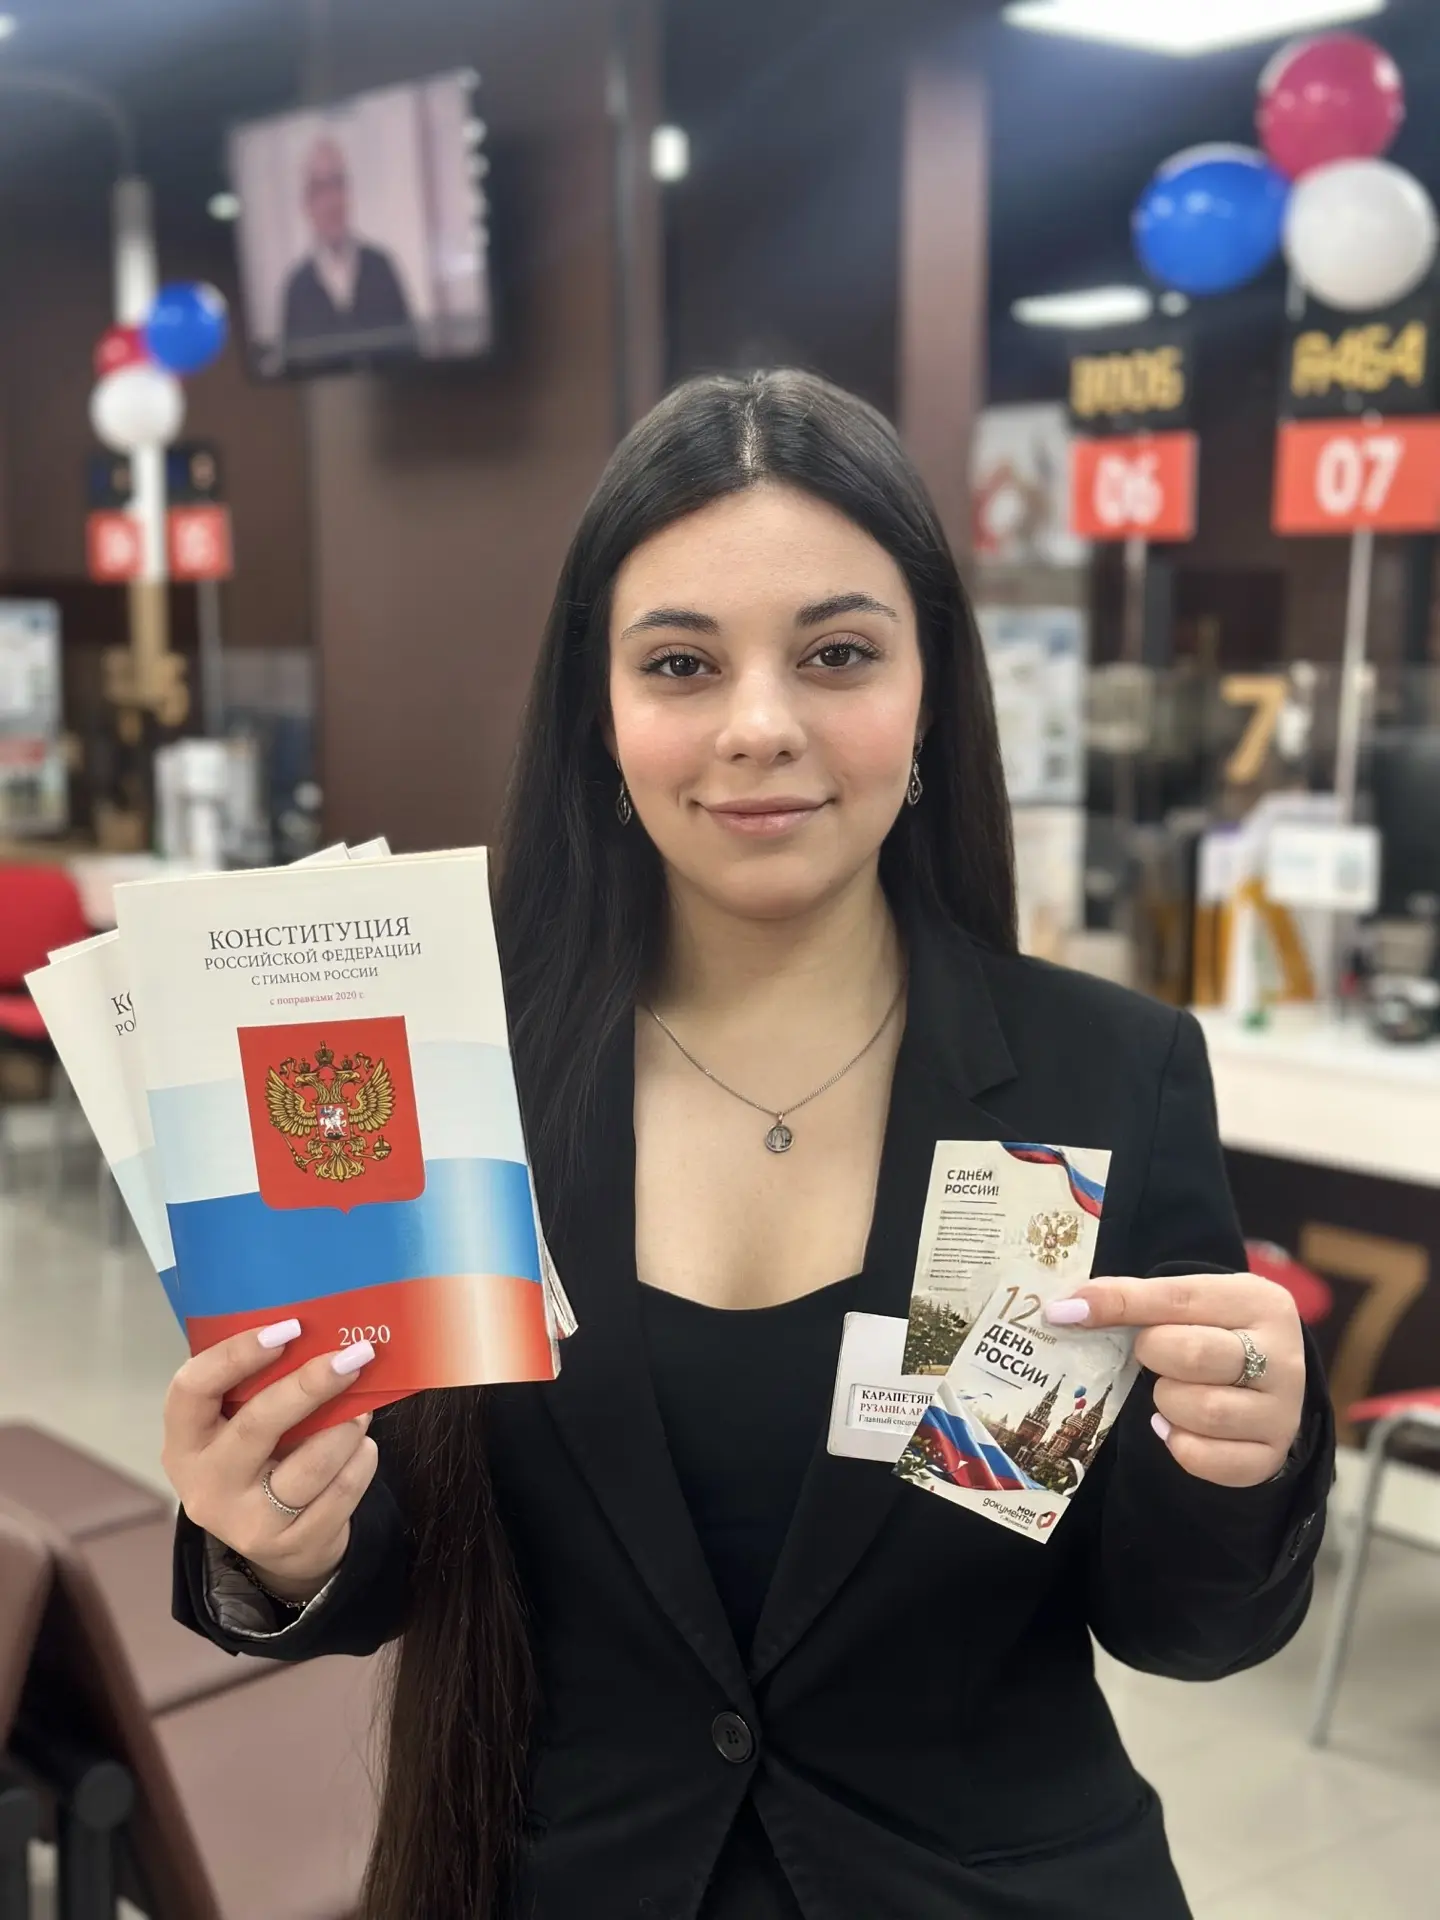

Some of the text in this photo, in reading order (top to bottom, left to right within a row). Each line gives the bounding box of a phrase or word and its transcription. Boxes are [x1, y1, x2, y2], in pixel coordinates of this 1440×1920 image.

[1314, 435, 1403, 515] 07
[208, 916, 412, 950] КОНСТИТУЦИЯ
[204, 942, 422, 970] РОССИЙСКОЙ ФЕДЕРАЦИИ
[251, 966, 379, 985] С ГИМНОМ РОССИИ
[276, 995, 334, 1006] поправками
[335, 990, 357, 1001] 2020
[947, 1168, 993, 1182] С ДНЁМ
[944, 1183, 1000, 1196] РОССИИ!
[997, 1286, 1042, 1332] 12
[338, 1324, 391, 1346] 2020
[983, 1323, 1034, 1357] ДЕНЬ
[974, 1341, 1050, 1388] РОССИИ
[862, 1389, 933, 1405] КАРАПЕТЯН
[859, 1413, 892, 1425] Главный
[860, 1403, 906, 1415] РУЗАННА
[982, 1497, 1034, 1525] документы
[1017, 1505, 1037, 1519] мои
